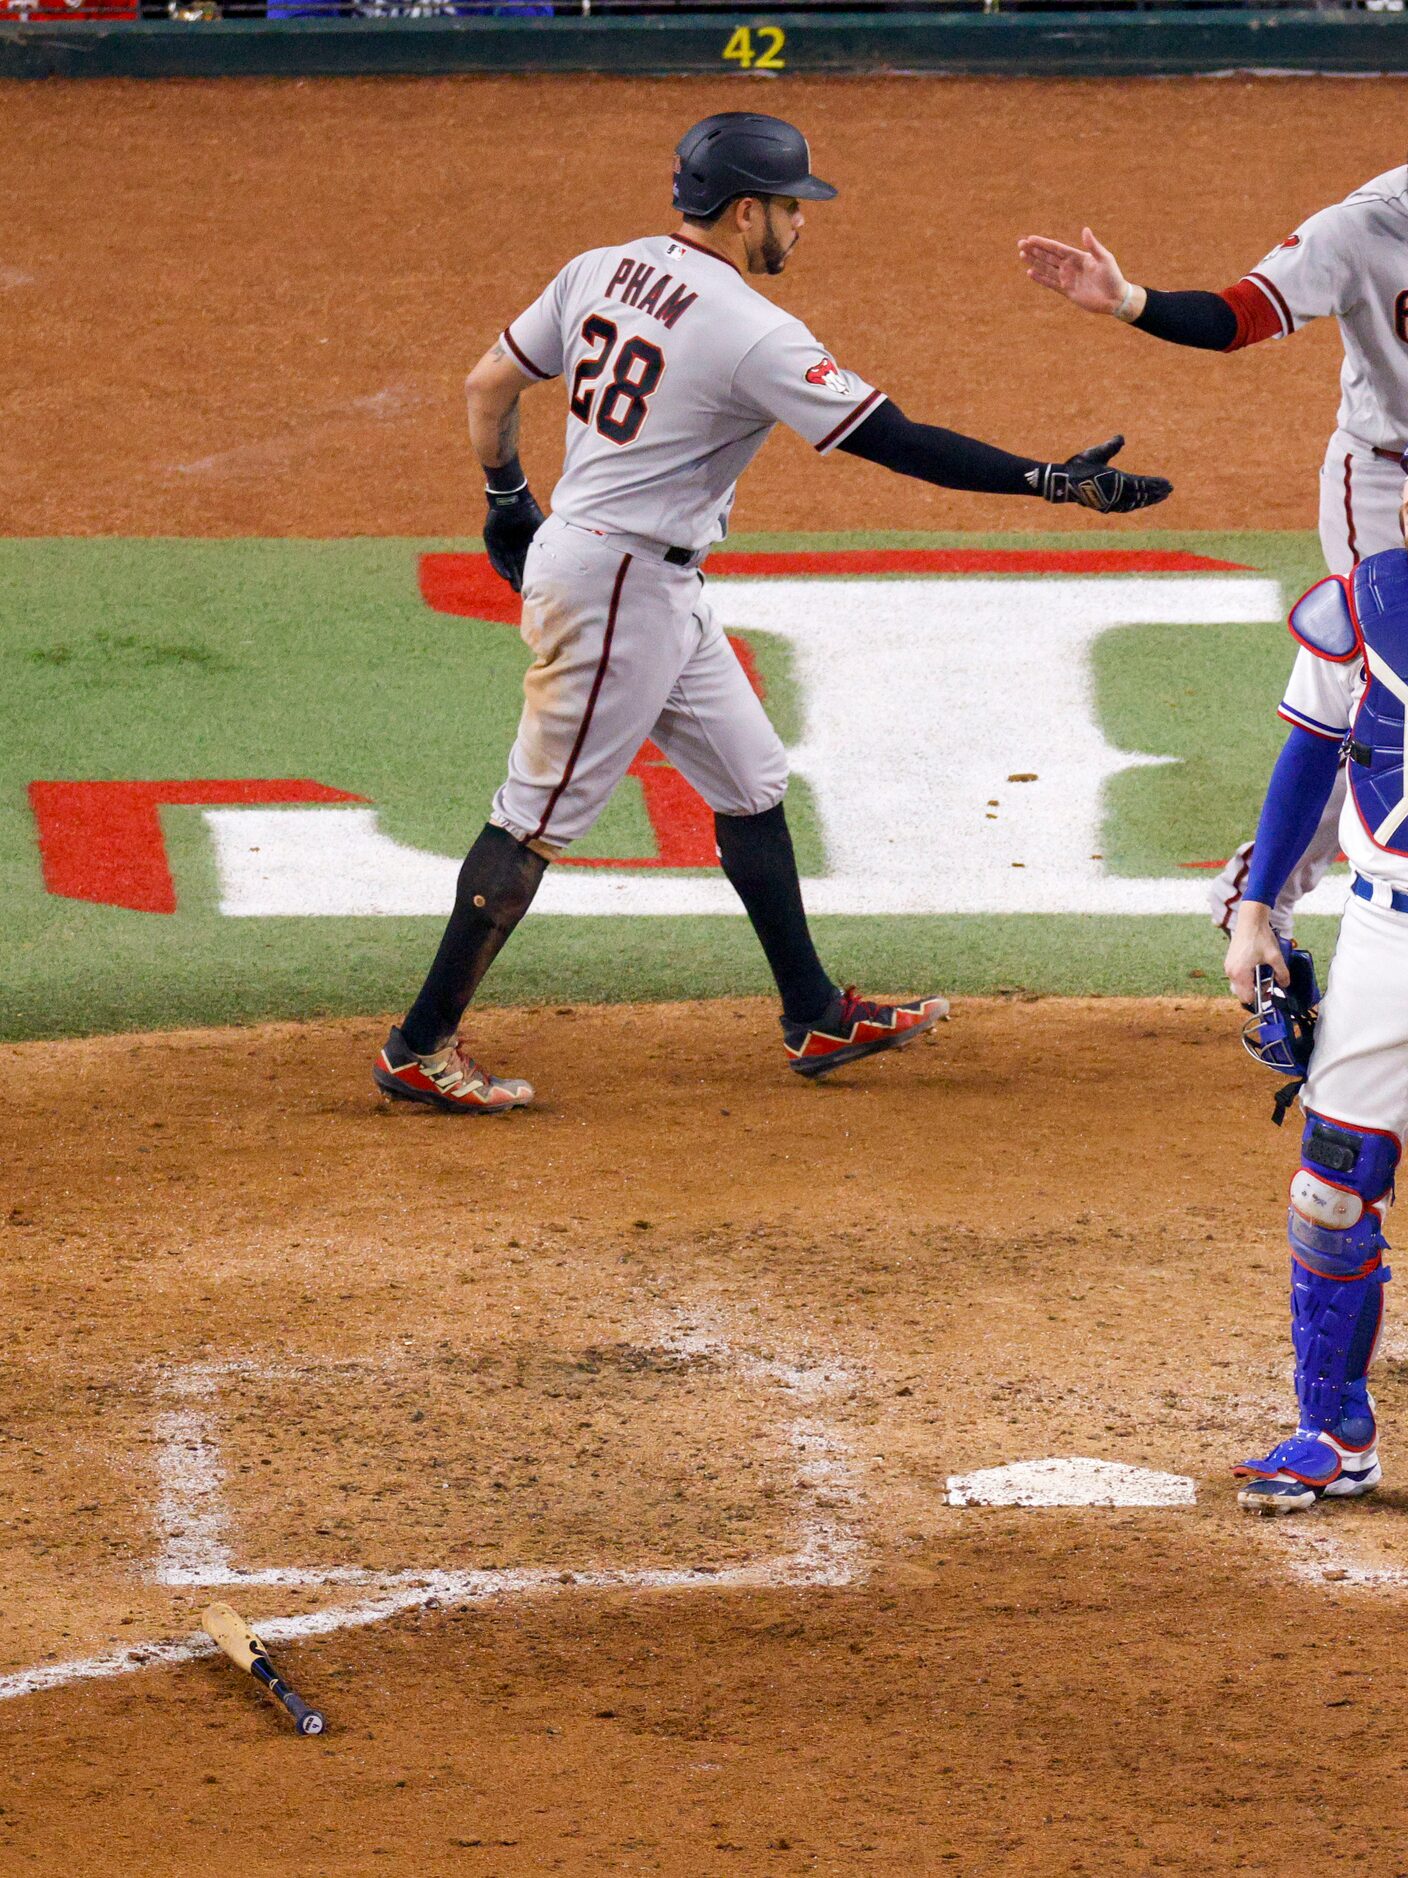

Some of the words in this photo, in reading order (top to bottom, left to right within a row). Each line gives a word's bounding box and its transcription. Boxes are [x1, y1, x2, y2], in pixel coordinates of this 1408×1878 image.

[722, 25, 786, 69] 42
[604, 257, 699, 331] PHAM
[570, 312, 667, 447] 28
